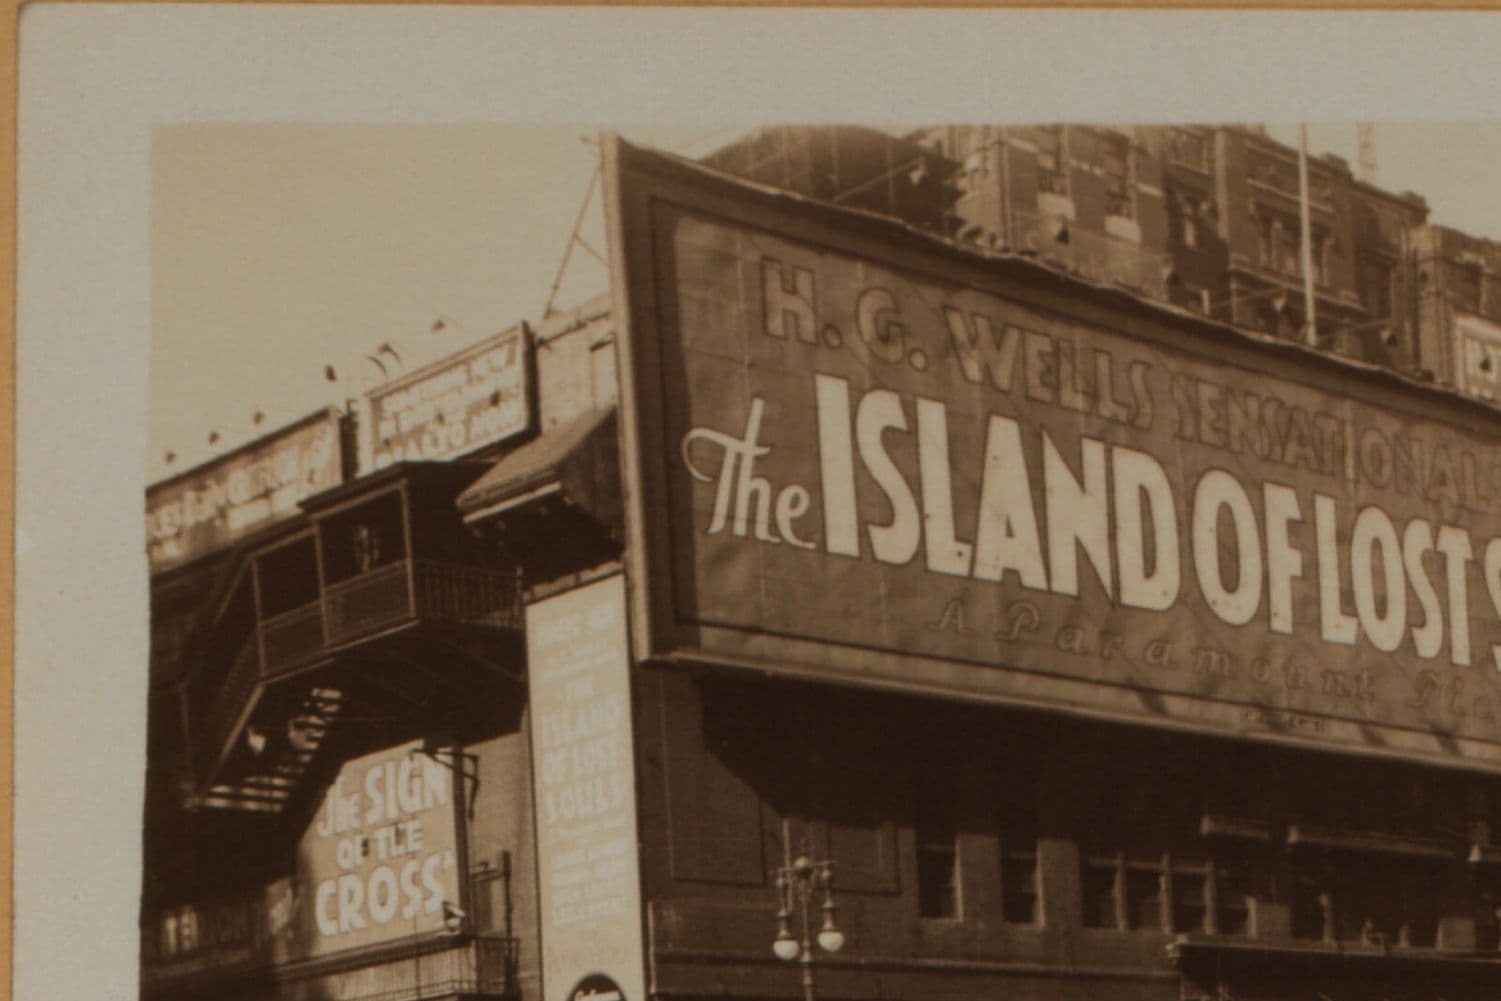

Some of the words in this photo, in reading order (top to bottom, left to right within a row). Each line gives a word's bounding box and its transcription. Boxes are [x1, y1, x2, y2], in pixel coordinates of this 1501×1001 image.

[761, 255, 842, 348] H.
[855, 285, 927, 374] G.
[942, 304, 1154, 432] WELLS
[1169, 374, 1491, 514] SENSATIONAL
[682, 397, 816, 549] The
[814, 373, 1180, 612] ISLAND
[1192, 467, 1303, 637] OF
[1313, 492, 1472, 668] LOST
[995, 600, 1377, 704] Paramount
[365, 752, 446, 828] SIGN
